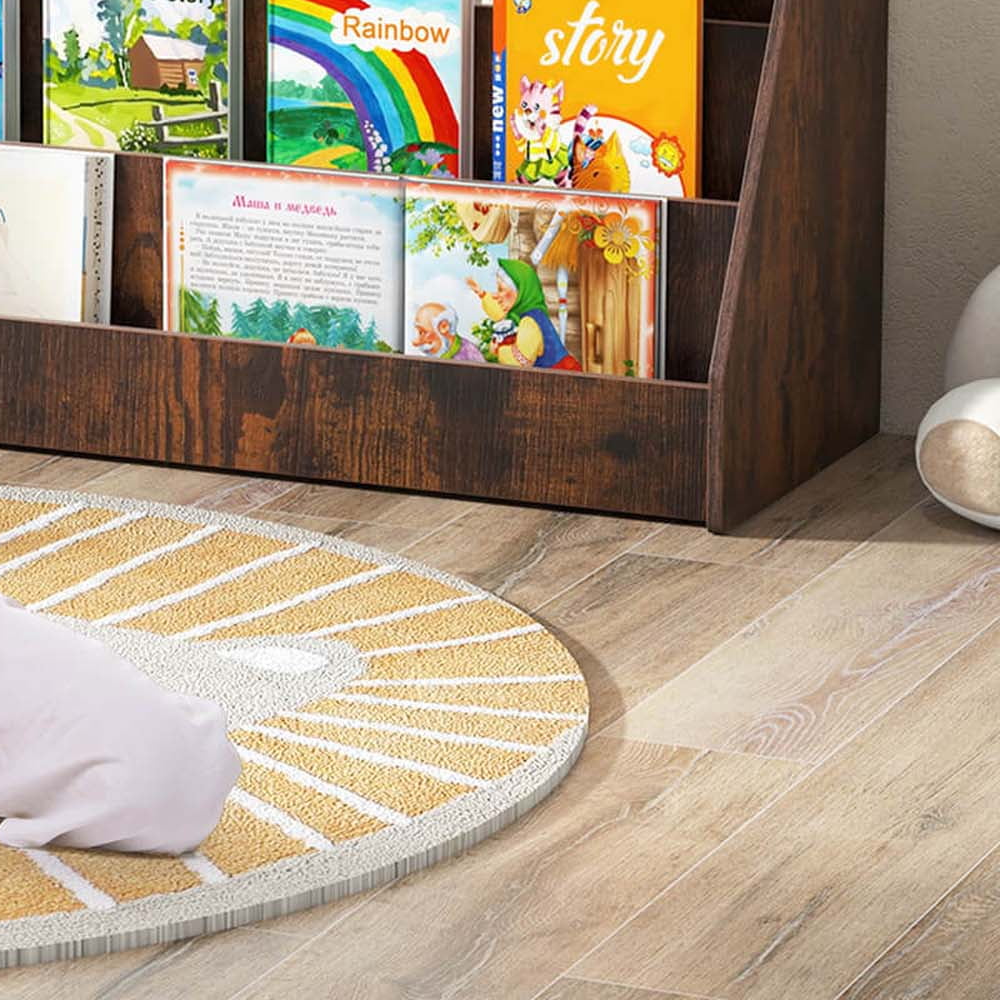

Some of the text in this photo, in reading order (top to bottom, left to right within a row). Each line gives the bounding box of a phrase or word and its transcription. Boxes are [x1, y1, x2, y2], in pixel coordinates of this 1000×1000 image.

[342, 15, 450, 45] Rainbow
[539, 0, 666, 85] story
[492, 86, 505, 132] new
[232, 194, 269, 210] Маша
[285, 202, 337, 217] медведь
